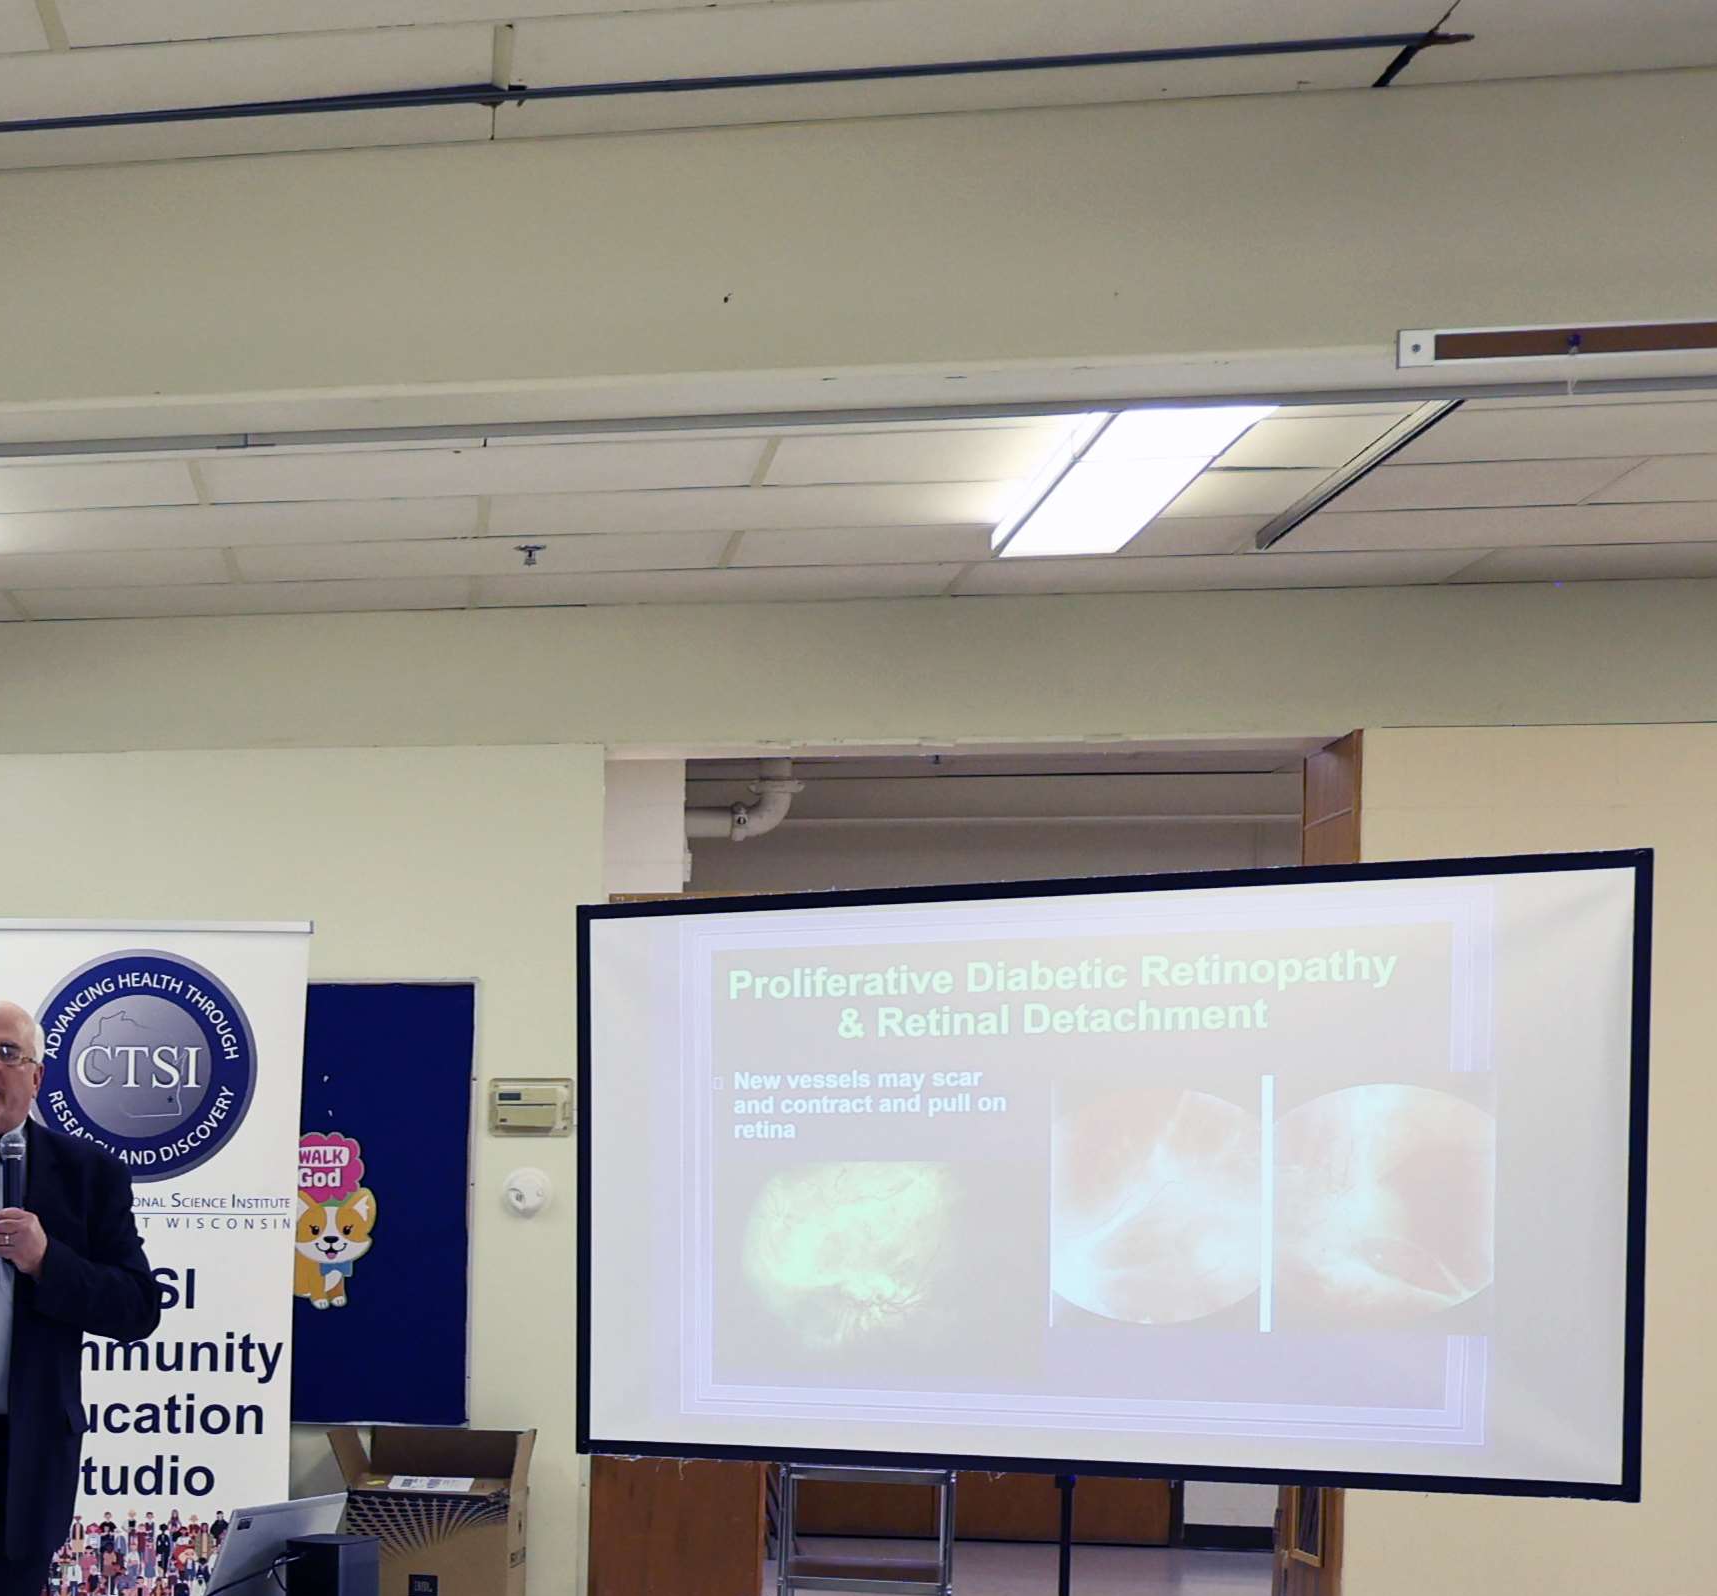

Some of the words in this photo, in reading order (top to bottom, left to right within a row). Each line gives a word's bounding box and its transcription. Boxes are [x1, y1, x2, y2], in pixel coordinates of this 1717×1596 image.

[728, 966, 954, 1000] Proliferative
[966, 957, 1128, 993] Diabetic
[1141, 949, 1398, 992] Retinopathy
[45, 978, 115, 1059] ADVANCING
[118, 972, 184, 994] HEALTH
[185, 985, 239, 1060] THROUGH
[838, 1008, 865, 1039] &
[877, 1004, 1010, 1038] Retinal
[1023, 998, 1269, 1035] Detachment
[76, 1045, 202, 1088] CTSI
[734, 1071, 780, 1090] New
[786, 1070, 871, 1090] vessels
[877, 1073, 925, 1092] may
[932, 1069, 983, 1088] scar
[119, 1149, 157, 1165] AND
[160, 1086, 235, 1162] DISCOVERY
[734, 1096, 774, 1115] and
[780, 1095, 873, 1115] contract
[878, 1094, 921, 1113] and
[928, 1093, 971, 1118] pull
[978, 1096, 1007, 1113] on
[734, 1120, 796, 1139] retina
[298, 1168, 341, 1188] God
[299, 1150, 343, 1165] WALK
[167, 1217, 291, 1230] WISCONSIN
[152, 1267, 196, 1310] SI
[81, 1455, 216, 1496] tudio
